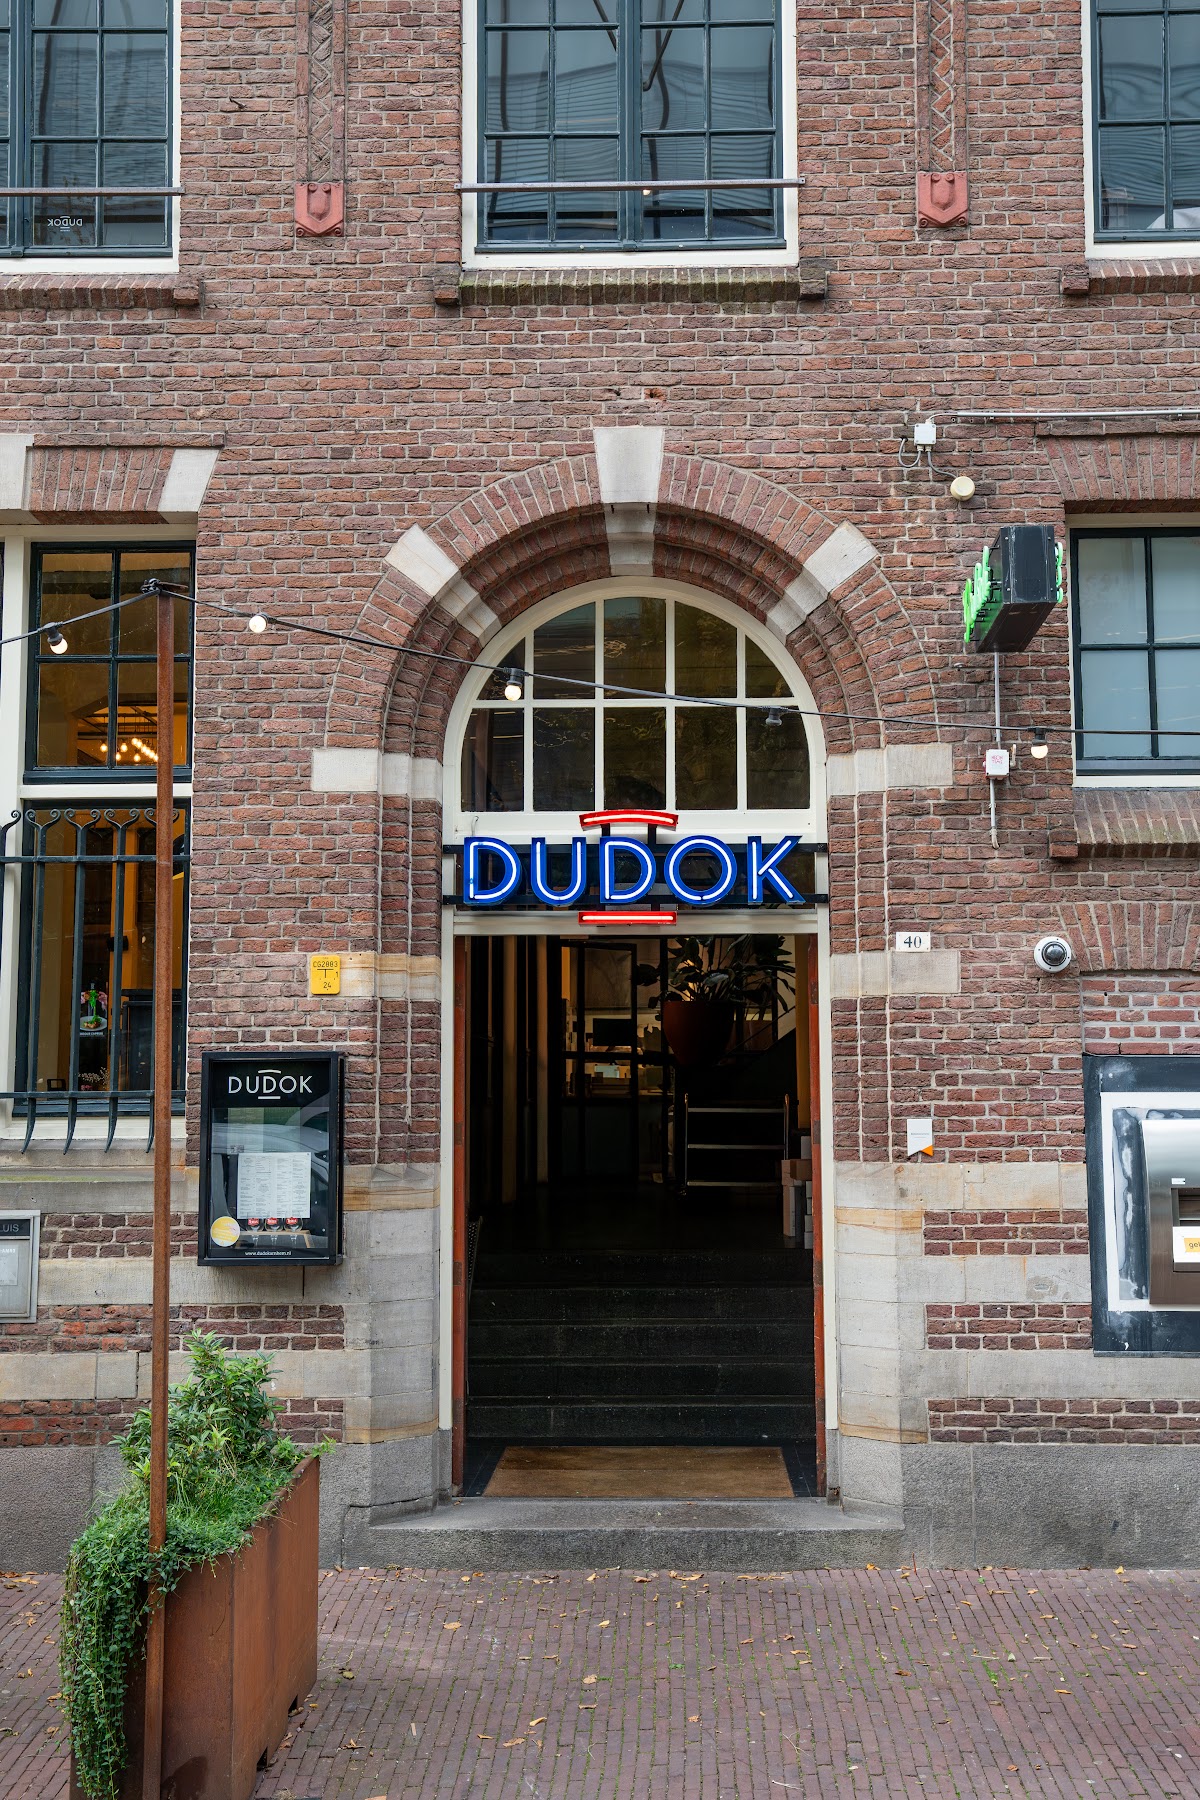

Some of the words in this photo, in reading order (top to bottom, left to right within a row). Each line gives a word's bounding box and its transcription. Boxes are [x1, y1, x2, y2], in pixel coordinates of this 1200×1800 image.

[463, 834, 806, 906] DUDOK
[903, 935, 922, 949] 40
[228, 1075, 313, 1094] DUDOK
